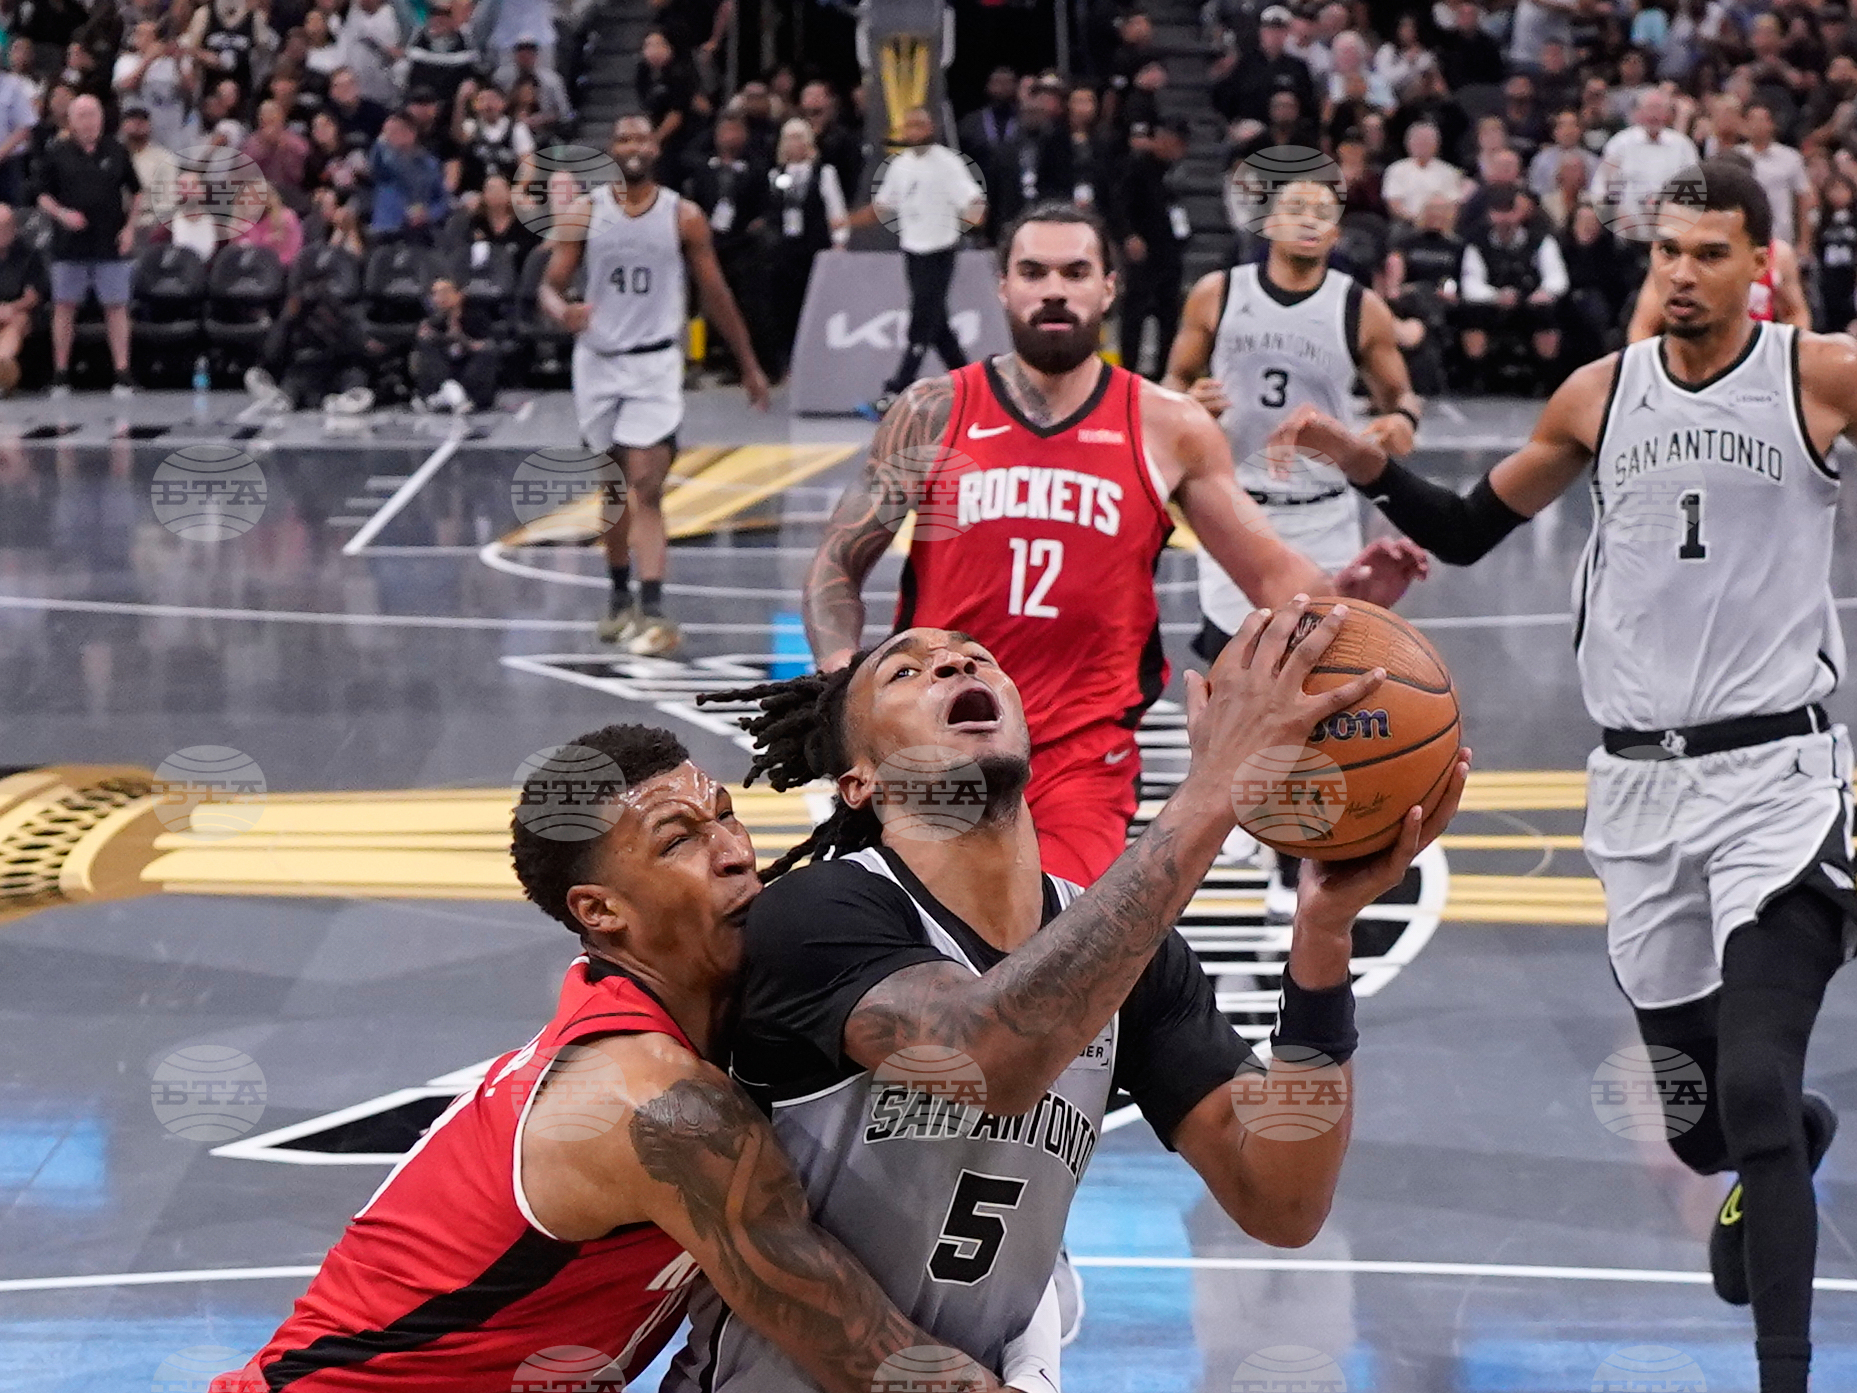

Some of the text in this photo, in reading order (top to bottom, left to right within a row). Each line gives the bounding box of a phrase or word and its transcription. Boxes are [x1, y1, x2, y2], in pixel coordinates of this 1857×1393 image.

[609, 265, 653, 296] 40
[1260, 367, 1289, 408] 3
[1614, 428, 1783, 488] SAN ANTONIO
[957, 465, 1124, 537] ROCKETS
[1677, 488, 1710, 562] 1
[1008, 537, 1064, 619] 12
[864, 1085, 970, 1145] SAN
[926, 1166, 1029, 1287] 5
